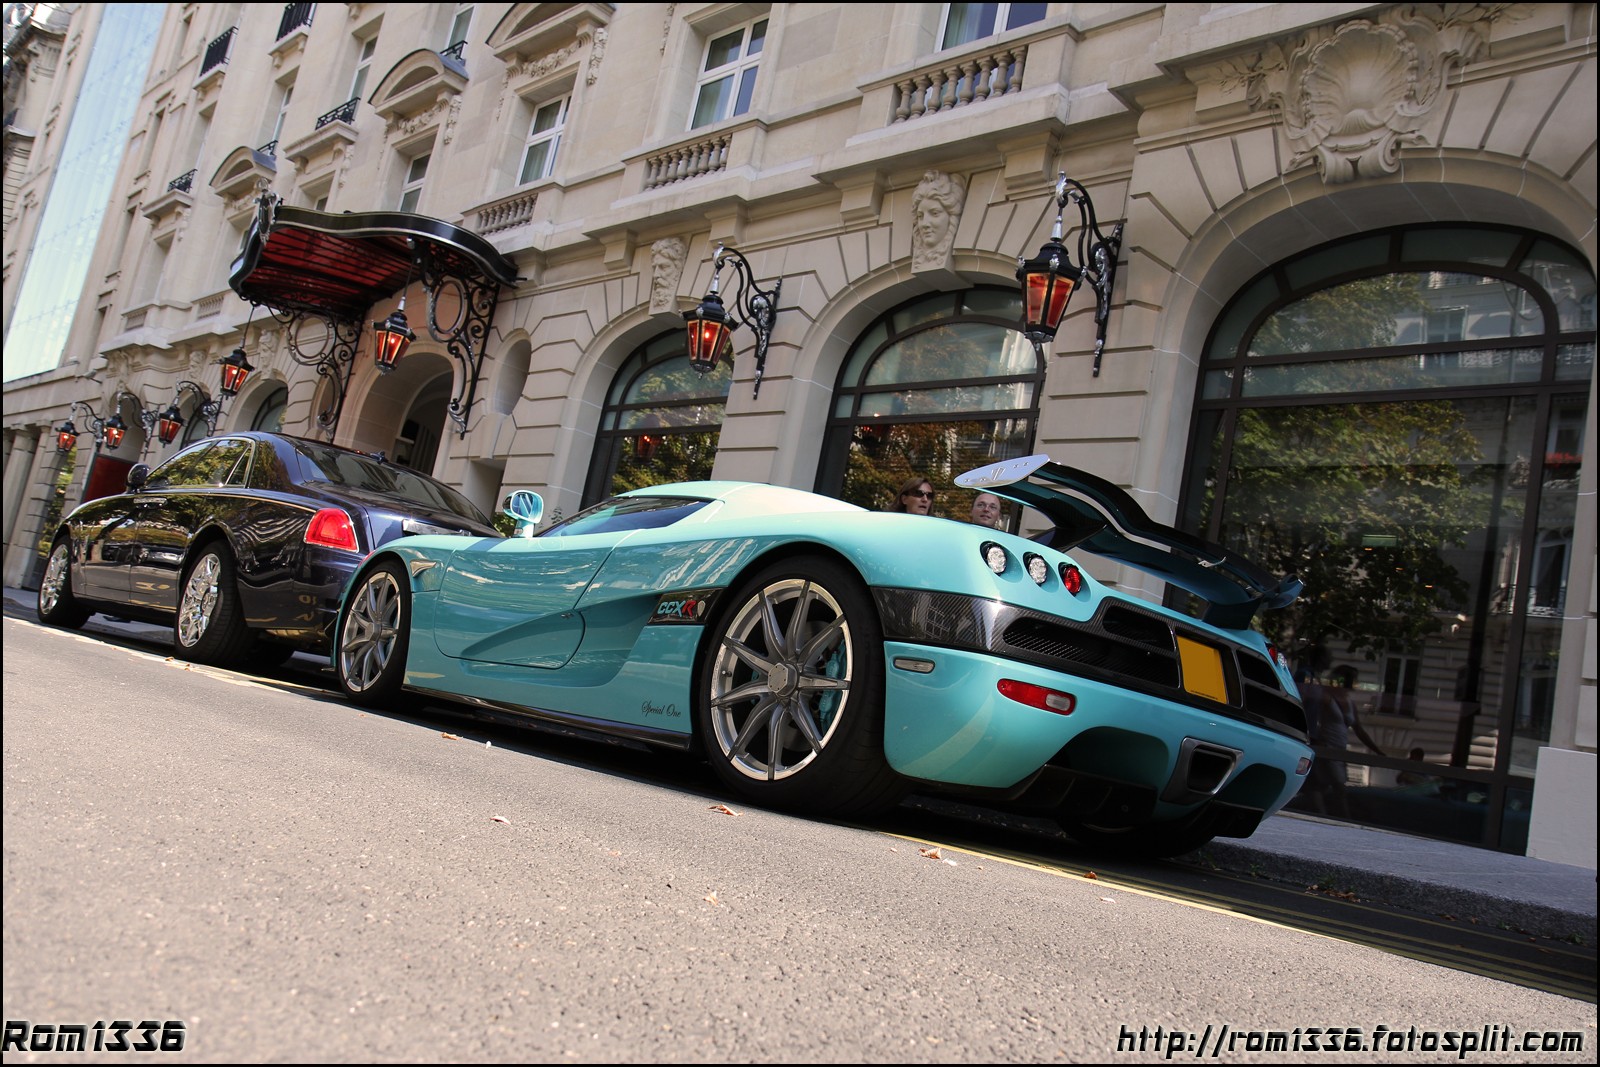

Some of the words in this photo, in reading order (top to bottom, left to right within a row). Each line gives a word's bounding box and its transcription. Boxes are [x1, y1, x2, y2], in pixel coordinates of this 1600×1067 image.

[657, 600, 697, 617] CCXR
[641, 701, 665, 717] Special
[666, 703, 681, 717] One
